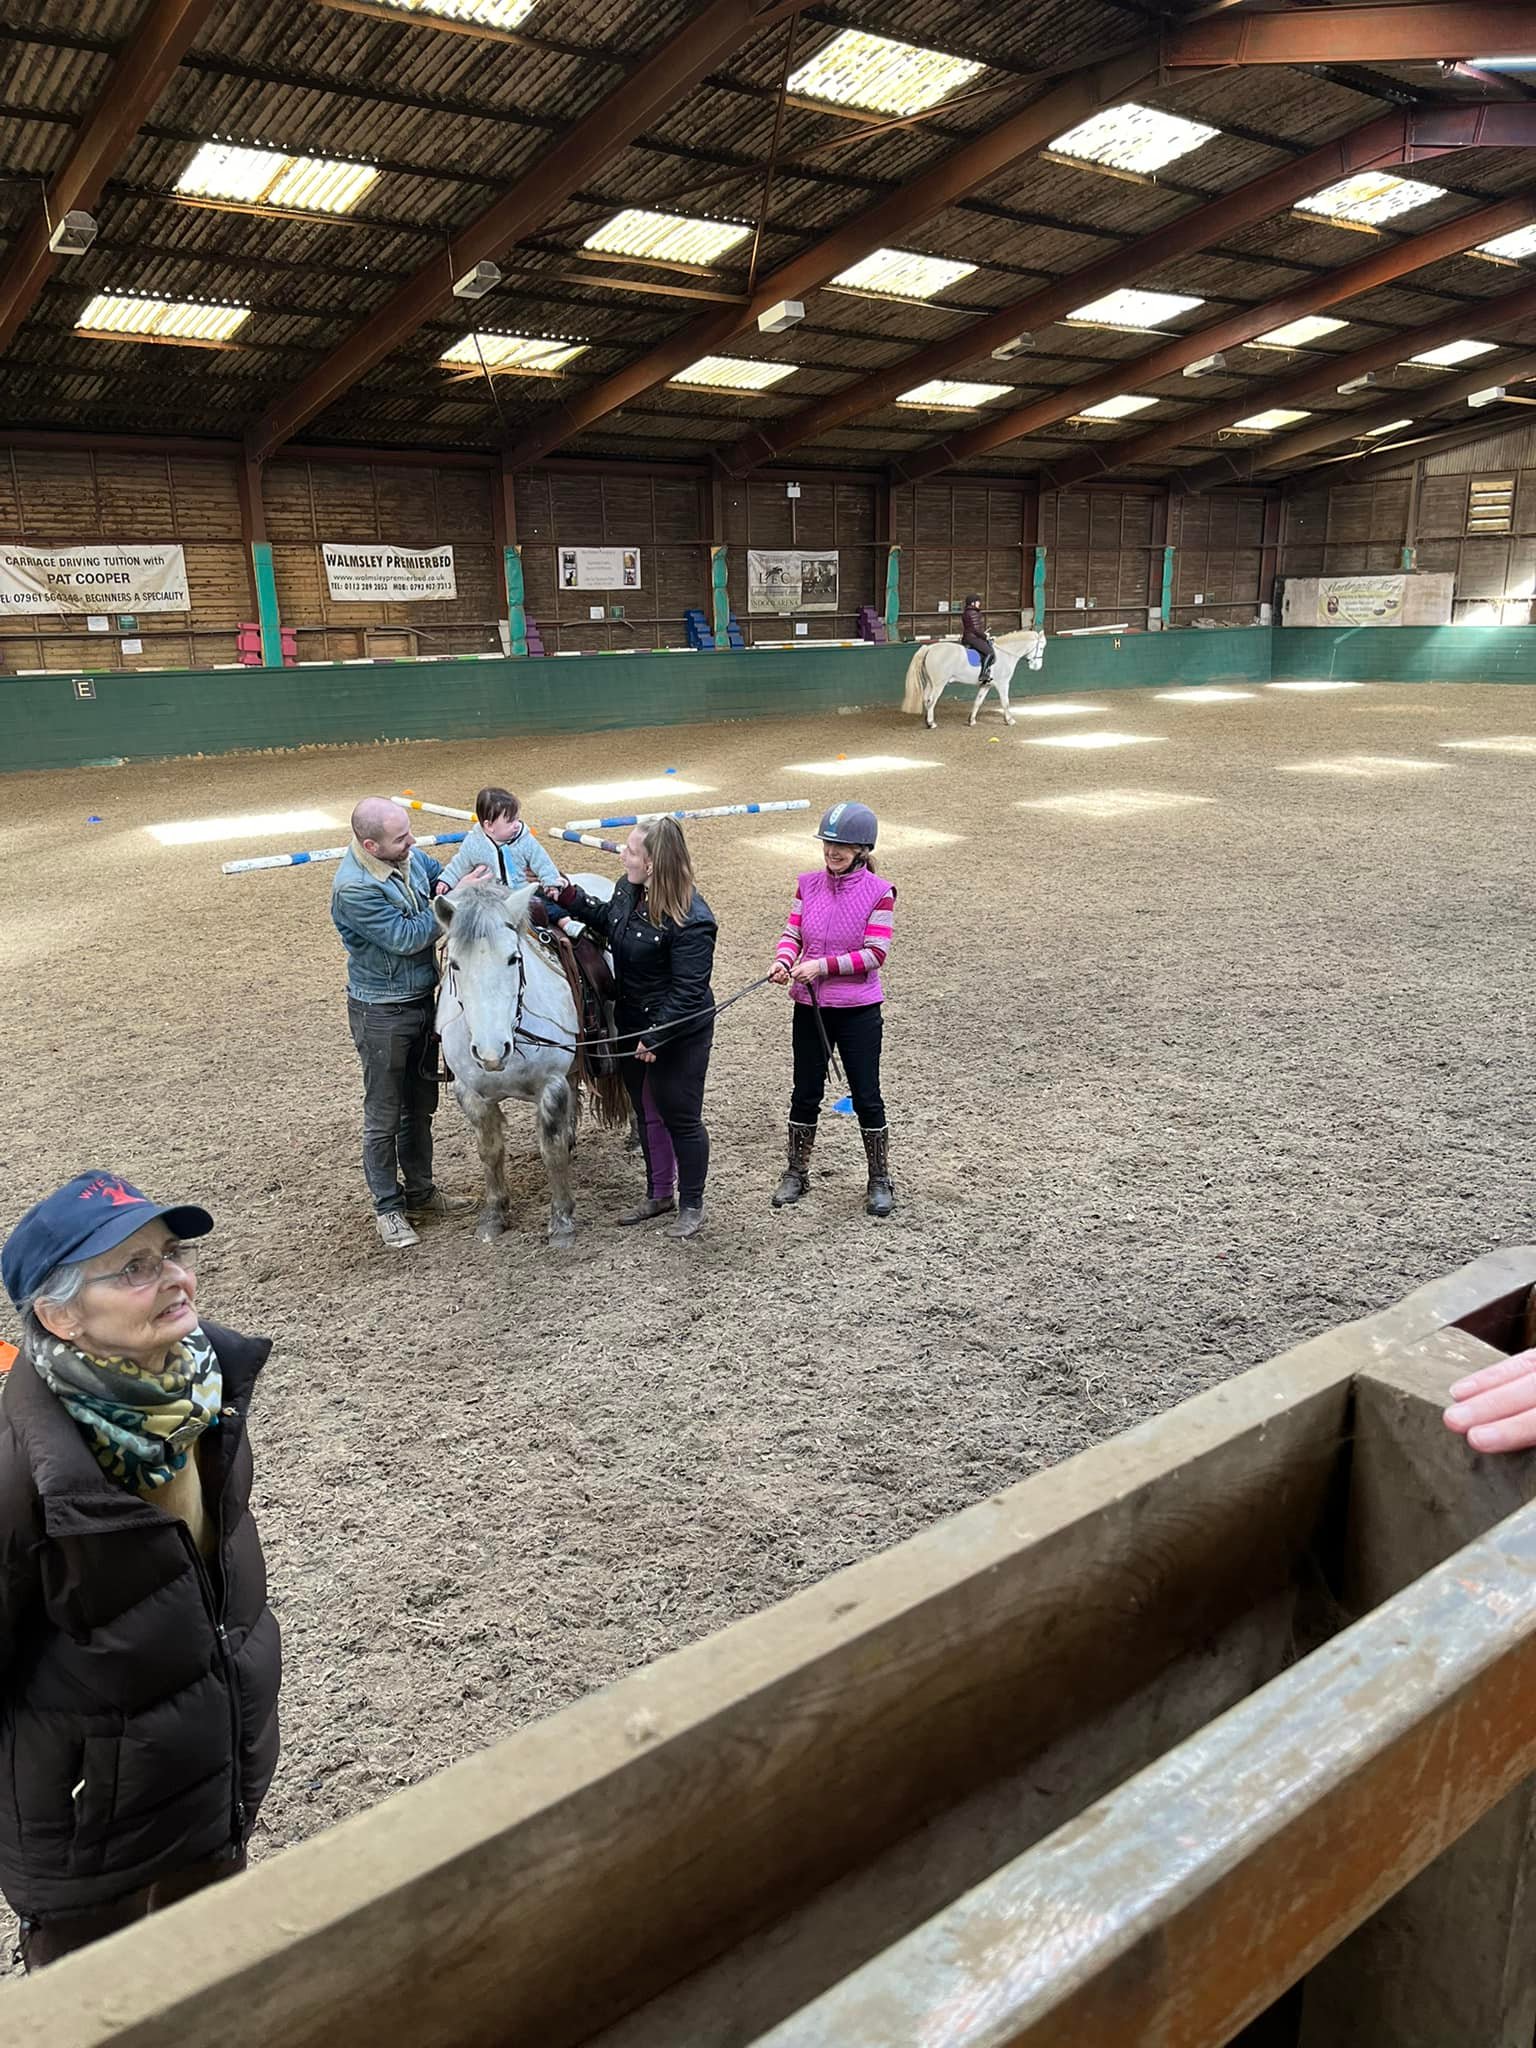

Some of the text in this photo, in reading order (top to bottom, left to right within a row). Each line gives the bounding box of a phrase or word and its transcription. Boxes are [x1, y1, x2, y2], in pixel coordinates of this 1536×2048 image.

[5, 556, 165, 567] CARRIAGE DRIVING TUITION with
[326, 554, 451, 569] WALMSLEY PREMIERBED
[47, 573, 130, 585] PAT COOPER
[13, 593, 42, 604] 07961
[85, 593, 132, 603] BEGINNERS
[134, 592, 141, 601] A
[142, 591, 184, 601] SPECIALITY
[1114, 639, 1121, 649] H
[78, 682, 91, 697] E
[79, 1179, 105, 1199] WYE
